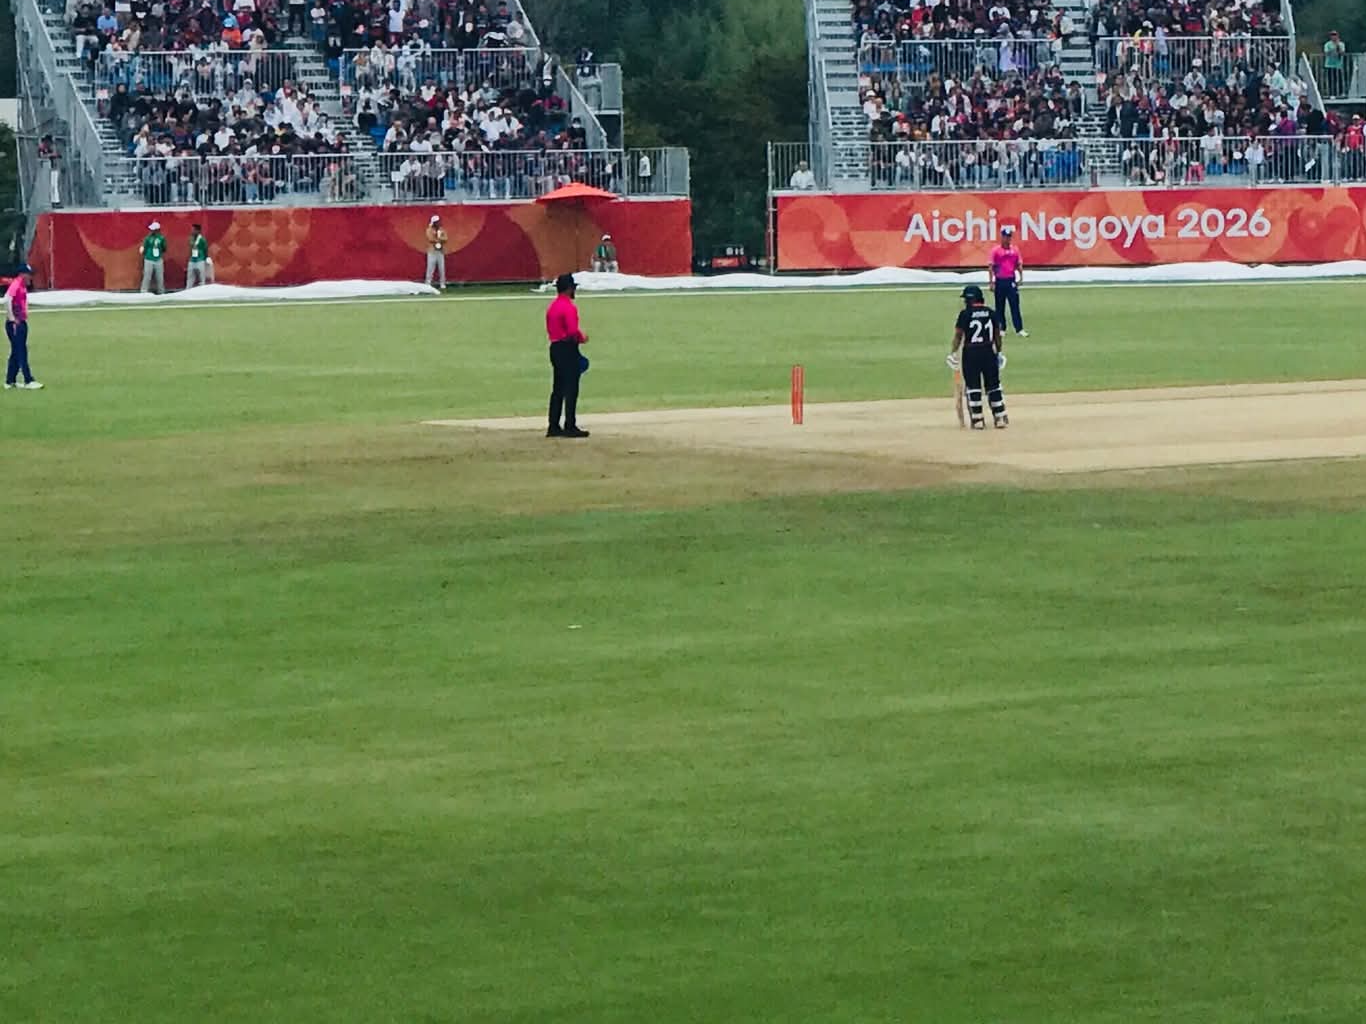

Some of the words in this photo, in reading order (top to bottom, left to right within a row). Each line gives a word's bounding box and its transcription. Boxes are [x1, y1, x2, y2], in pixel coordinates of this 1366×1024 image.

[903, 208, 1166, 250] Aichi-Nagoya
[1176, 208, 1272, 239] 2026
[969, 318, 994, 343] 21
